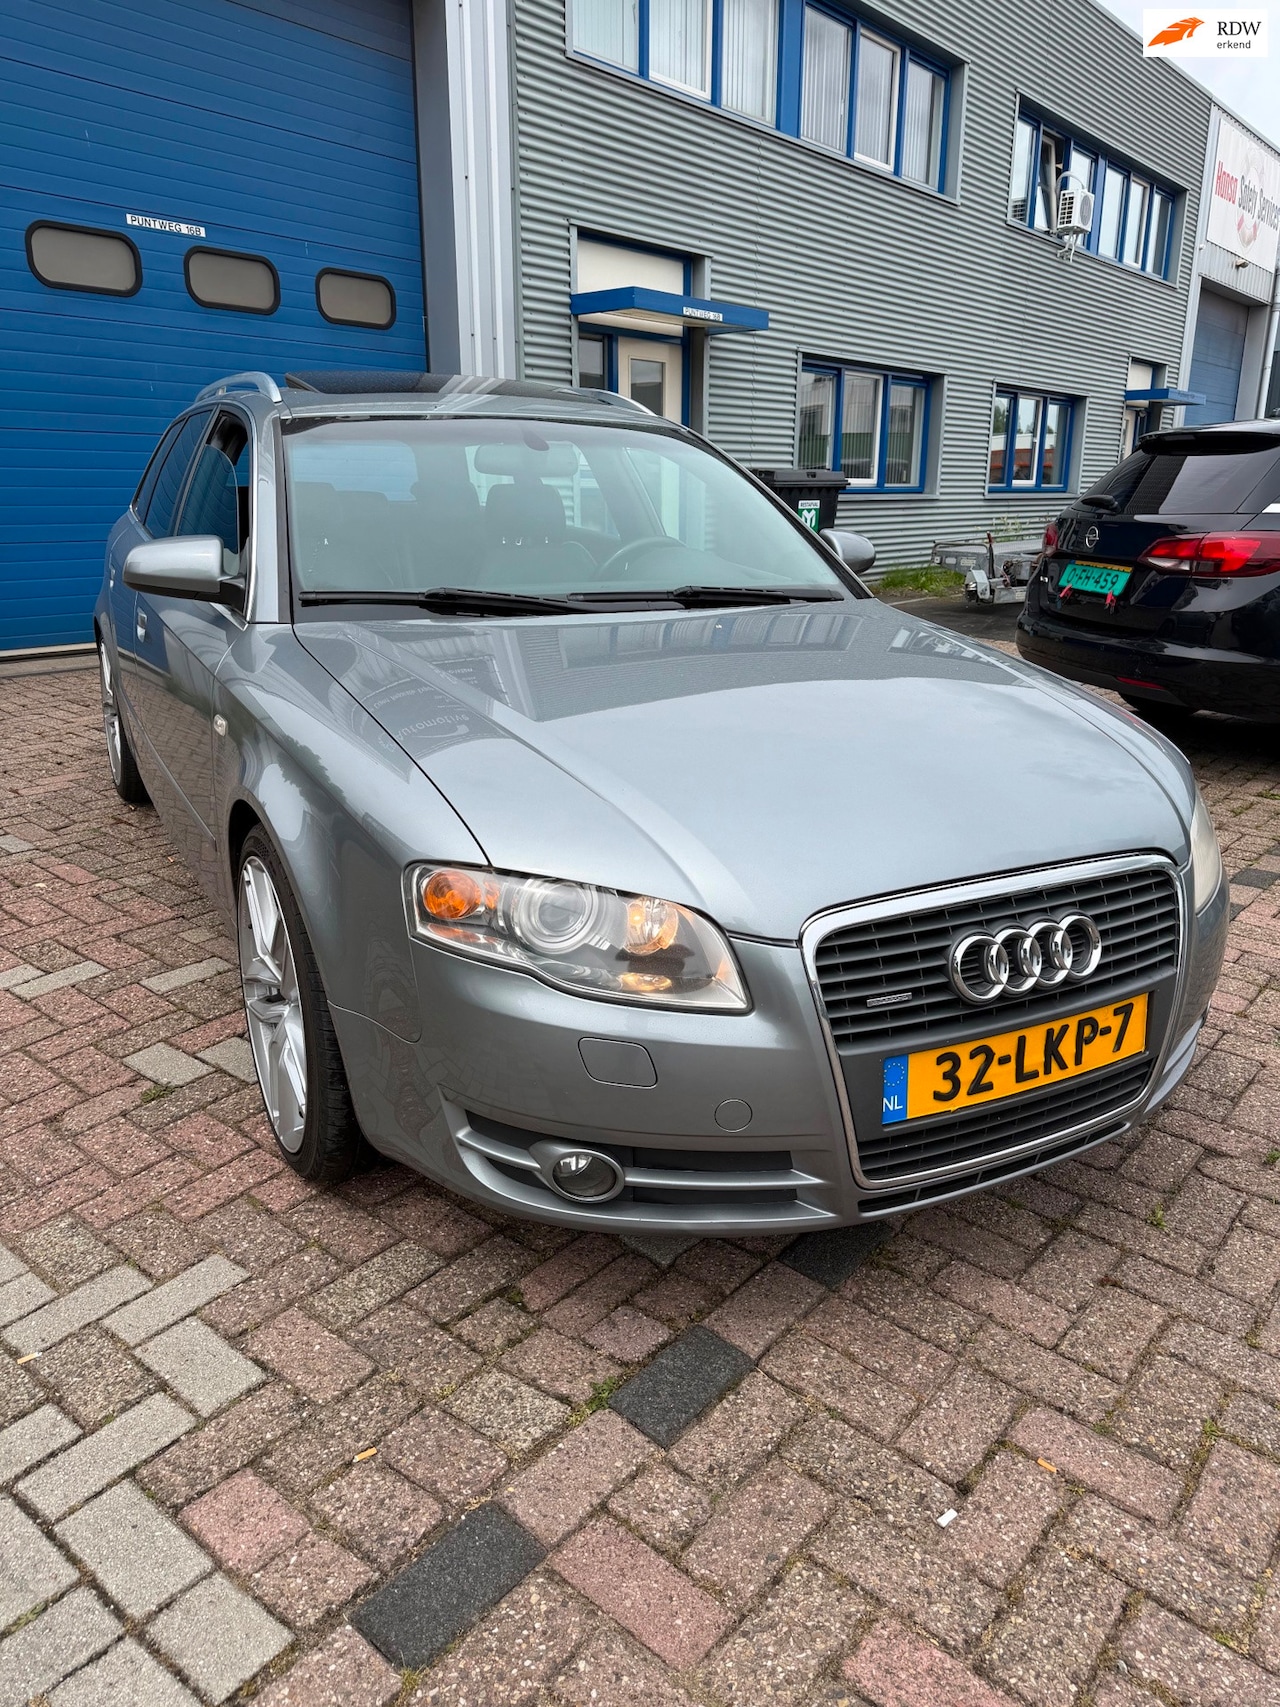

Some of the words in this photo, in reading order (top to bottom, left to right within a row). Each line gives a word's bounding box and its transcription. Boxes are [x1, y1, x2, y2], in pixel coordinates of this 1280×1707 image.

[1215, 160, 1238, 205] Hansa
[1238, 174, 1259, 220] Safety
[130, 215, 182, 233] PUNTWEG
[185, 226, 202, 236] 16B
[933, 1002, 1134, 1102] 32-LKP-7
[882, 1095, 903, 1112] NL
